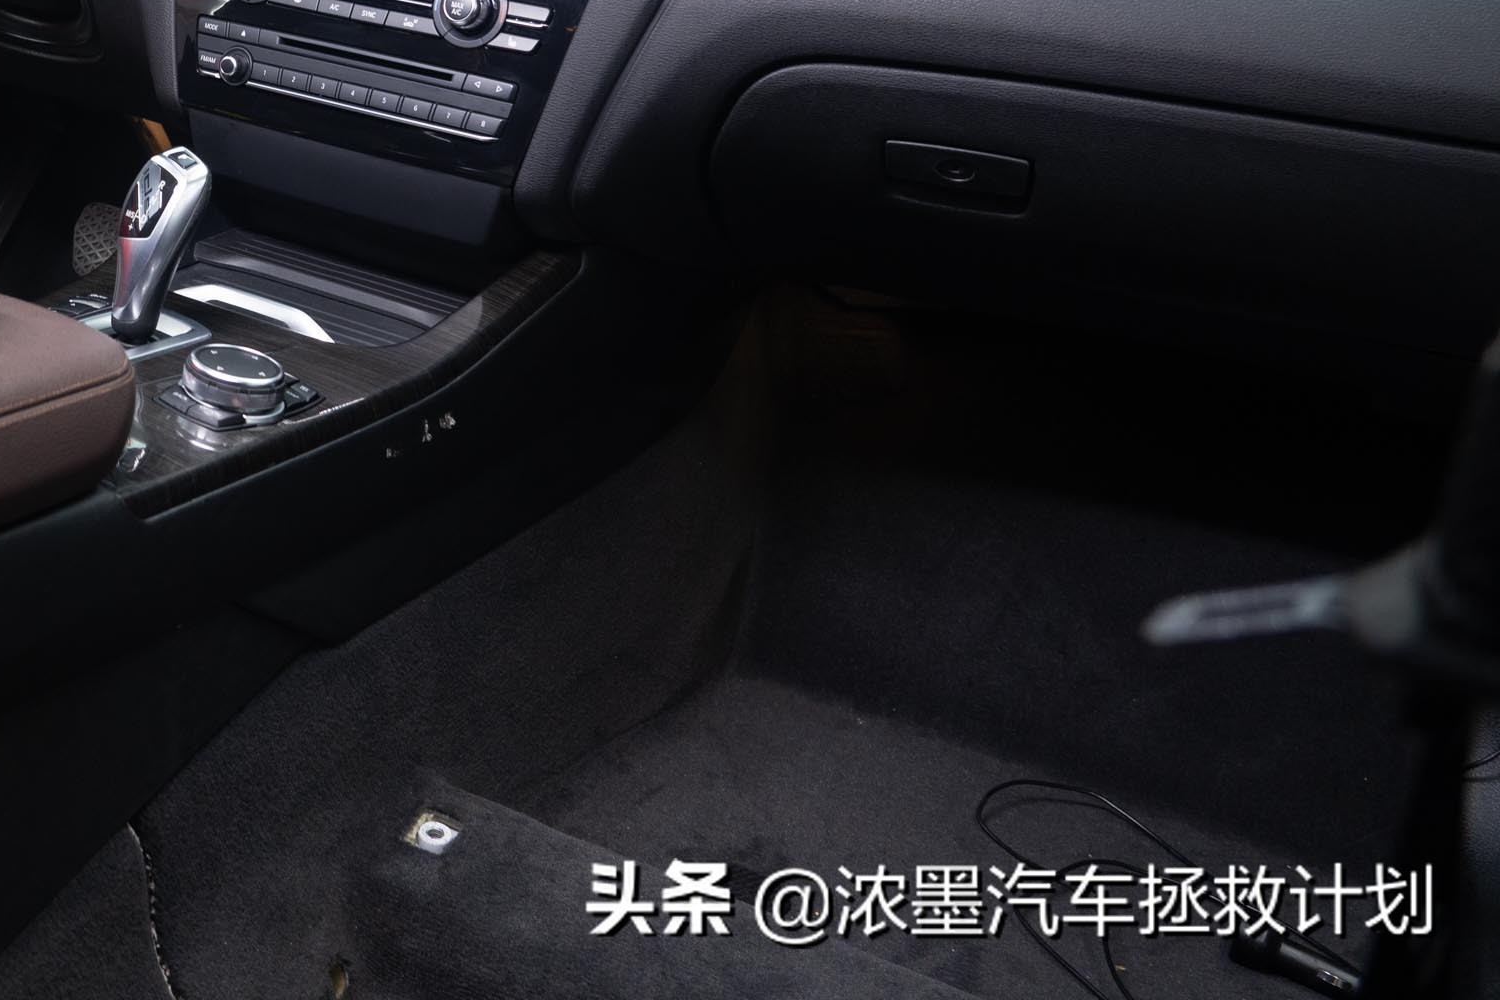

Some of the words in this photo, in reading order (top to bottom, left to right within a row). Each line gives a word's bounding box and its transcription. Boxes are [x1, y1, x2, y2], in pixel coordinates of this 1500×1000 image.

[329, 3, 340, 11] A/C
[450, 1, 464, 9] MAX
[361, 10, 376, 19] SYNC
[451, 9, 462, 17] A/C
[204, 22, 219, 32] MODE
[200, 55, 217, 65] FM/AM
